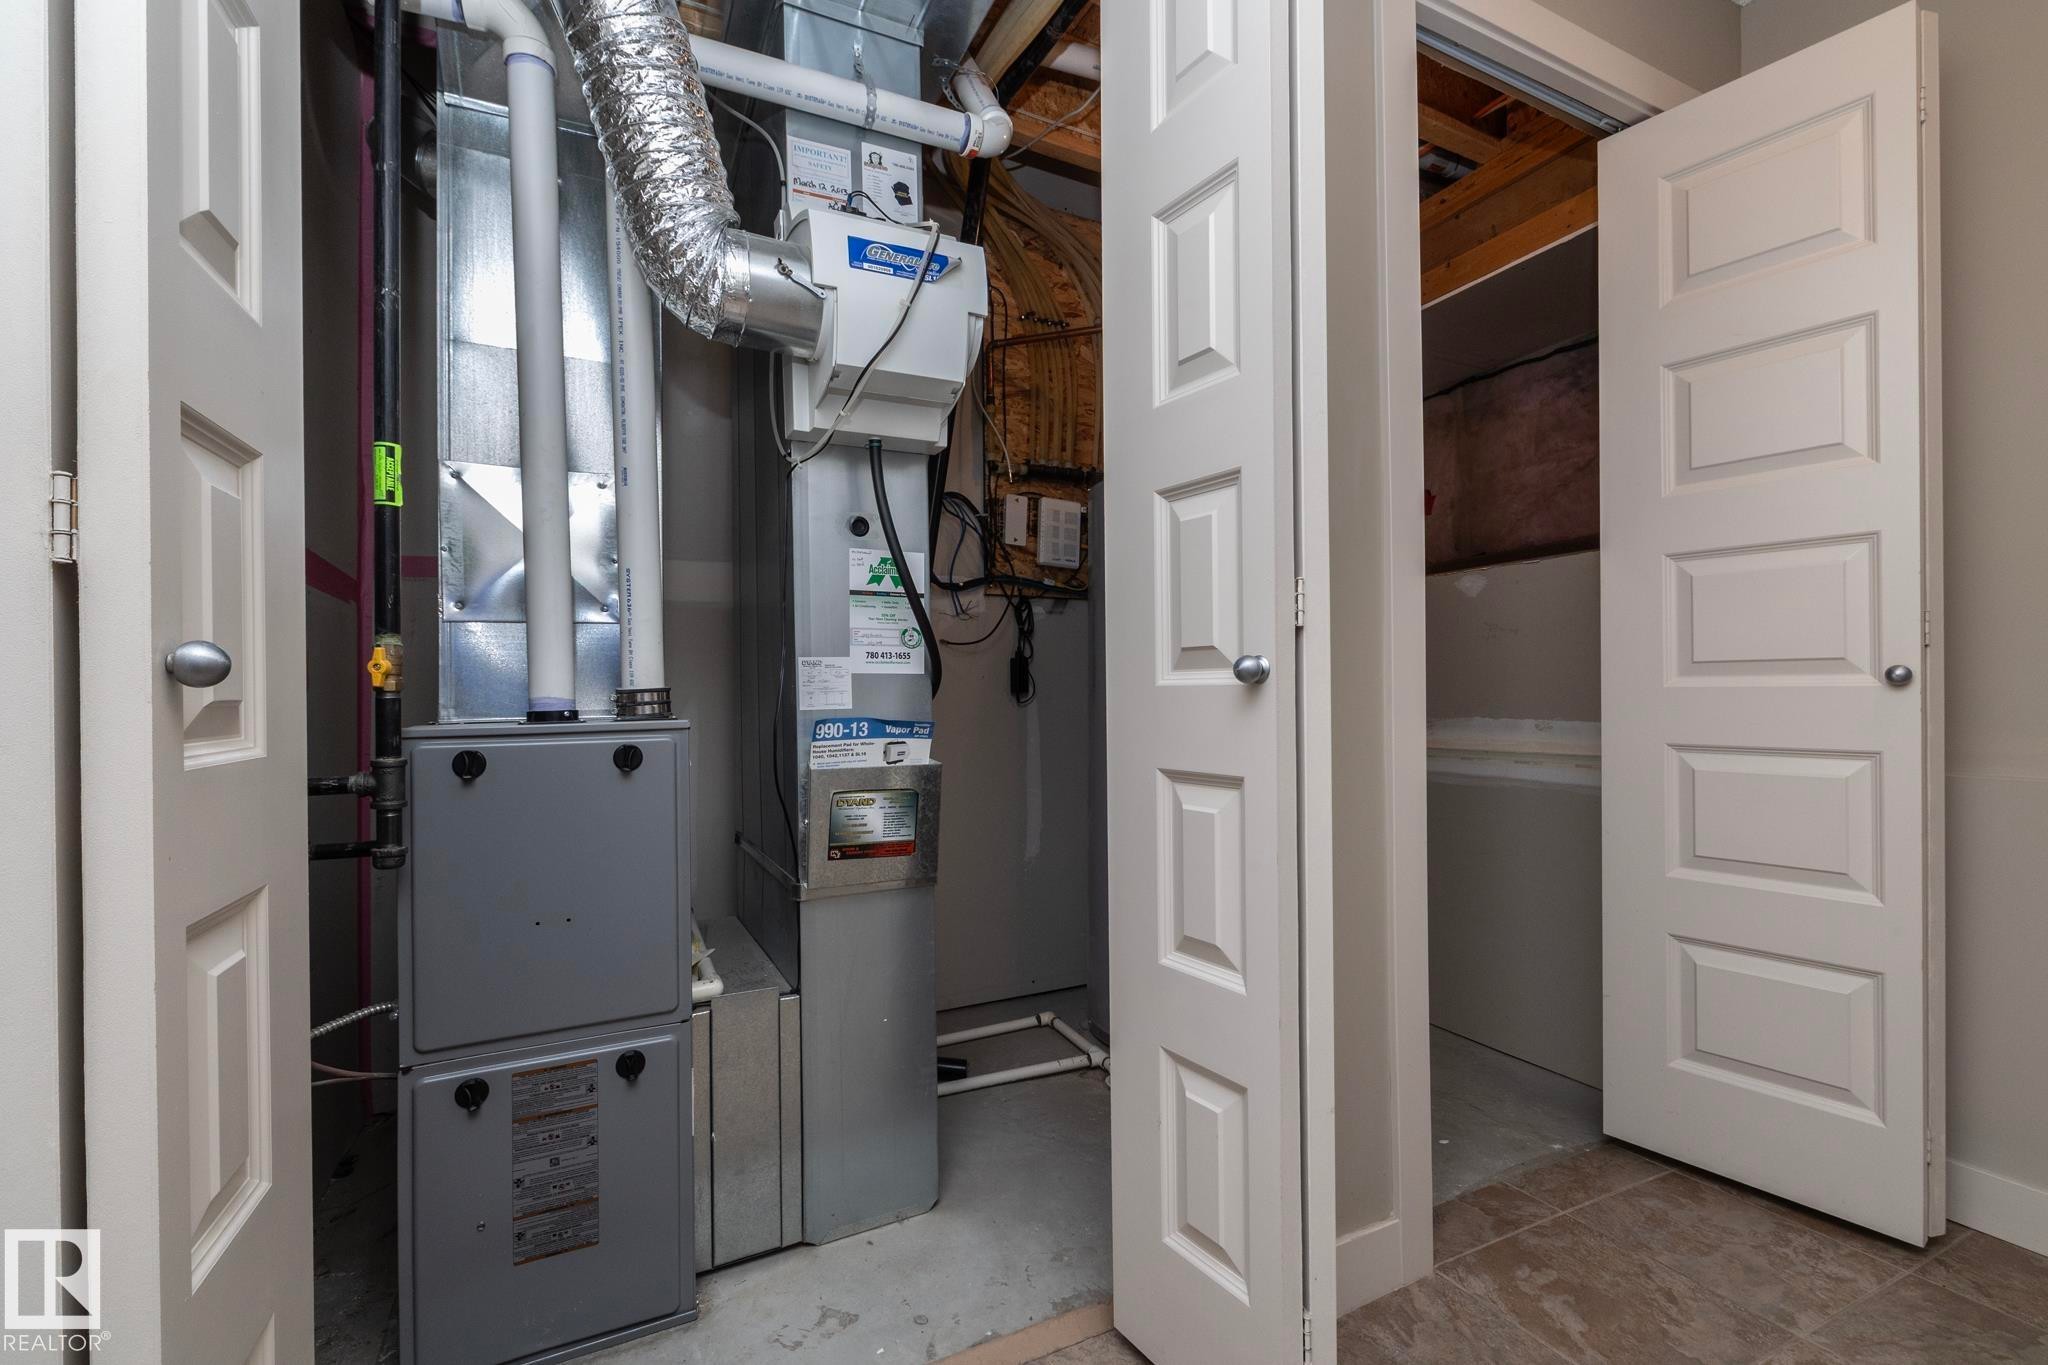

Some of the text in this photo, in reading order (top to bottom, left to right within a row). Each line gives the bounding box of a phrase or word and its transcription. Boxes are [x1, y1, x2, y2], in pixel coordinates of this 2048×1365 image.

[793, 144, 847, 163] IMPORTANT!
[793, 177, 817, 189] March
[819, 182, 827, 191] 12
[386, 456, 395, 492] ACCEPTABLE
[865, 651, 911, 660] 780 413-1655
[815, 721, 869, 739] 990-13
[885, 724, 911, 735] Vapor
[913, 726, 930, 735] Pad
